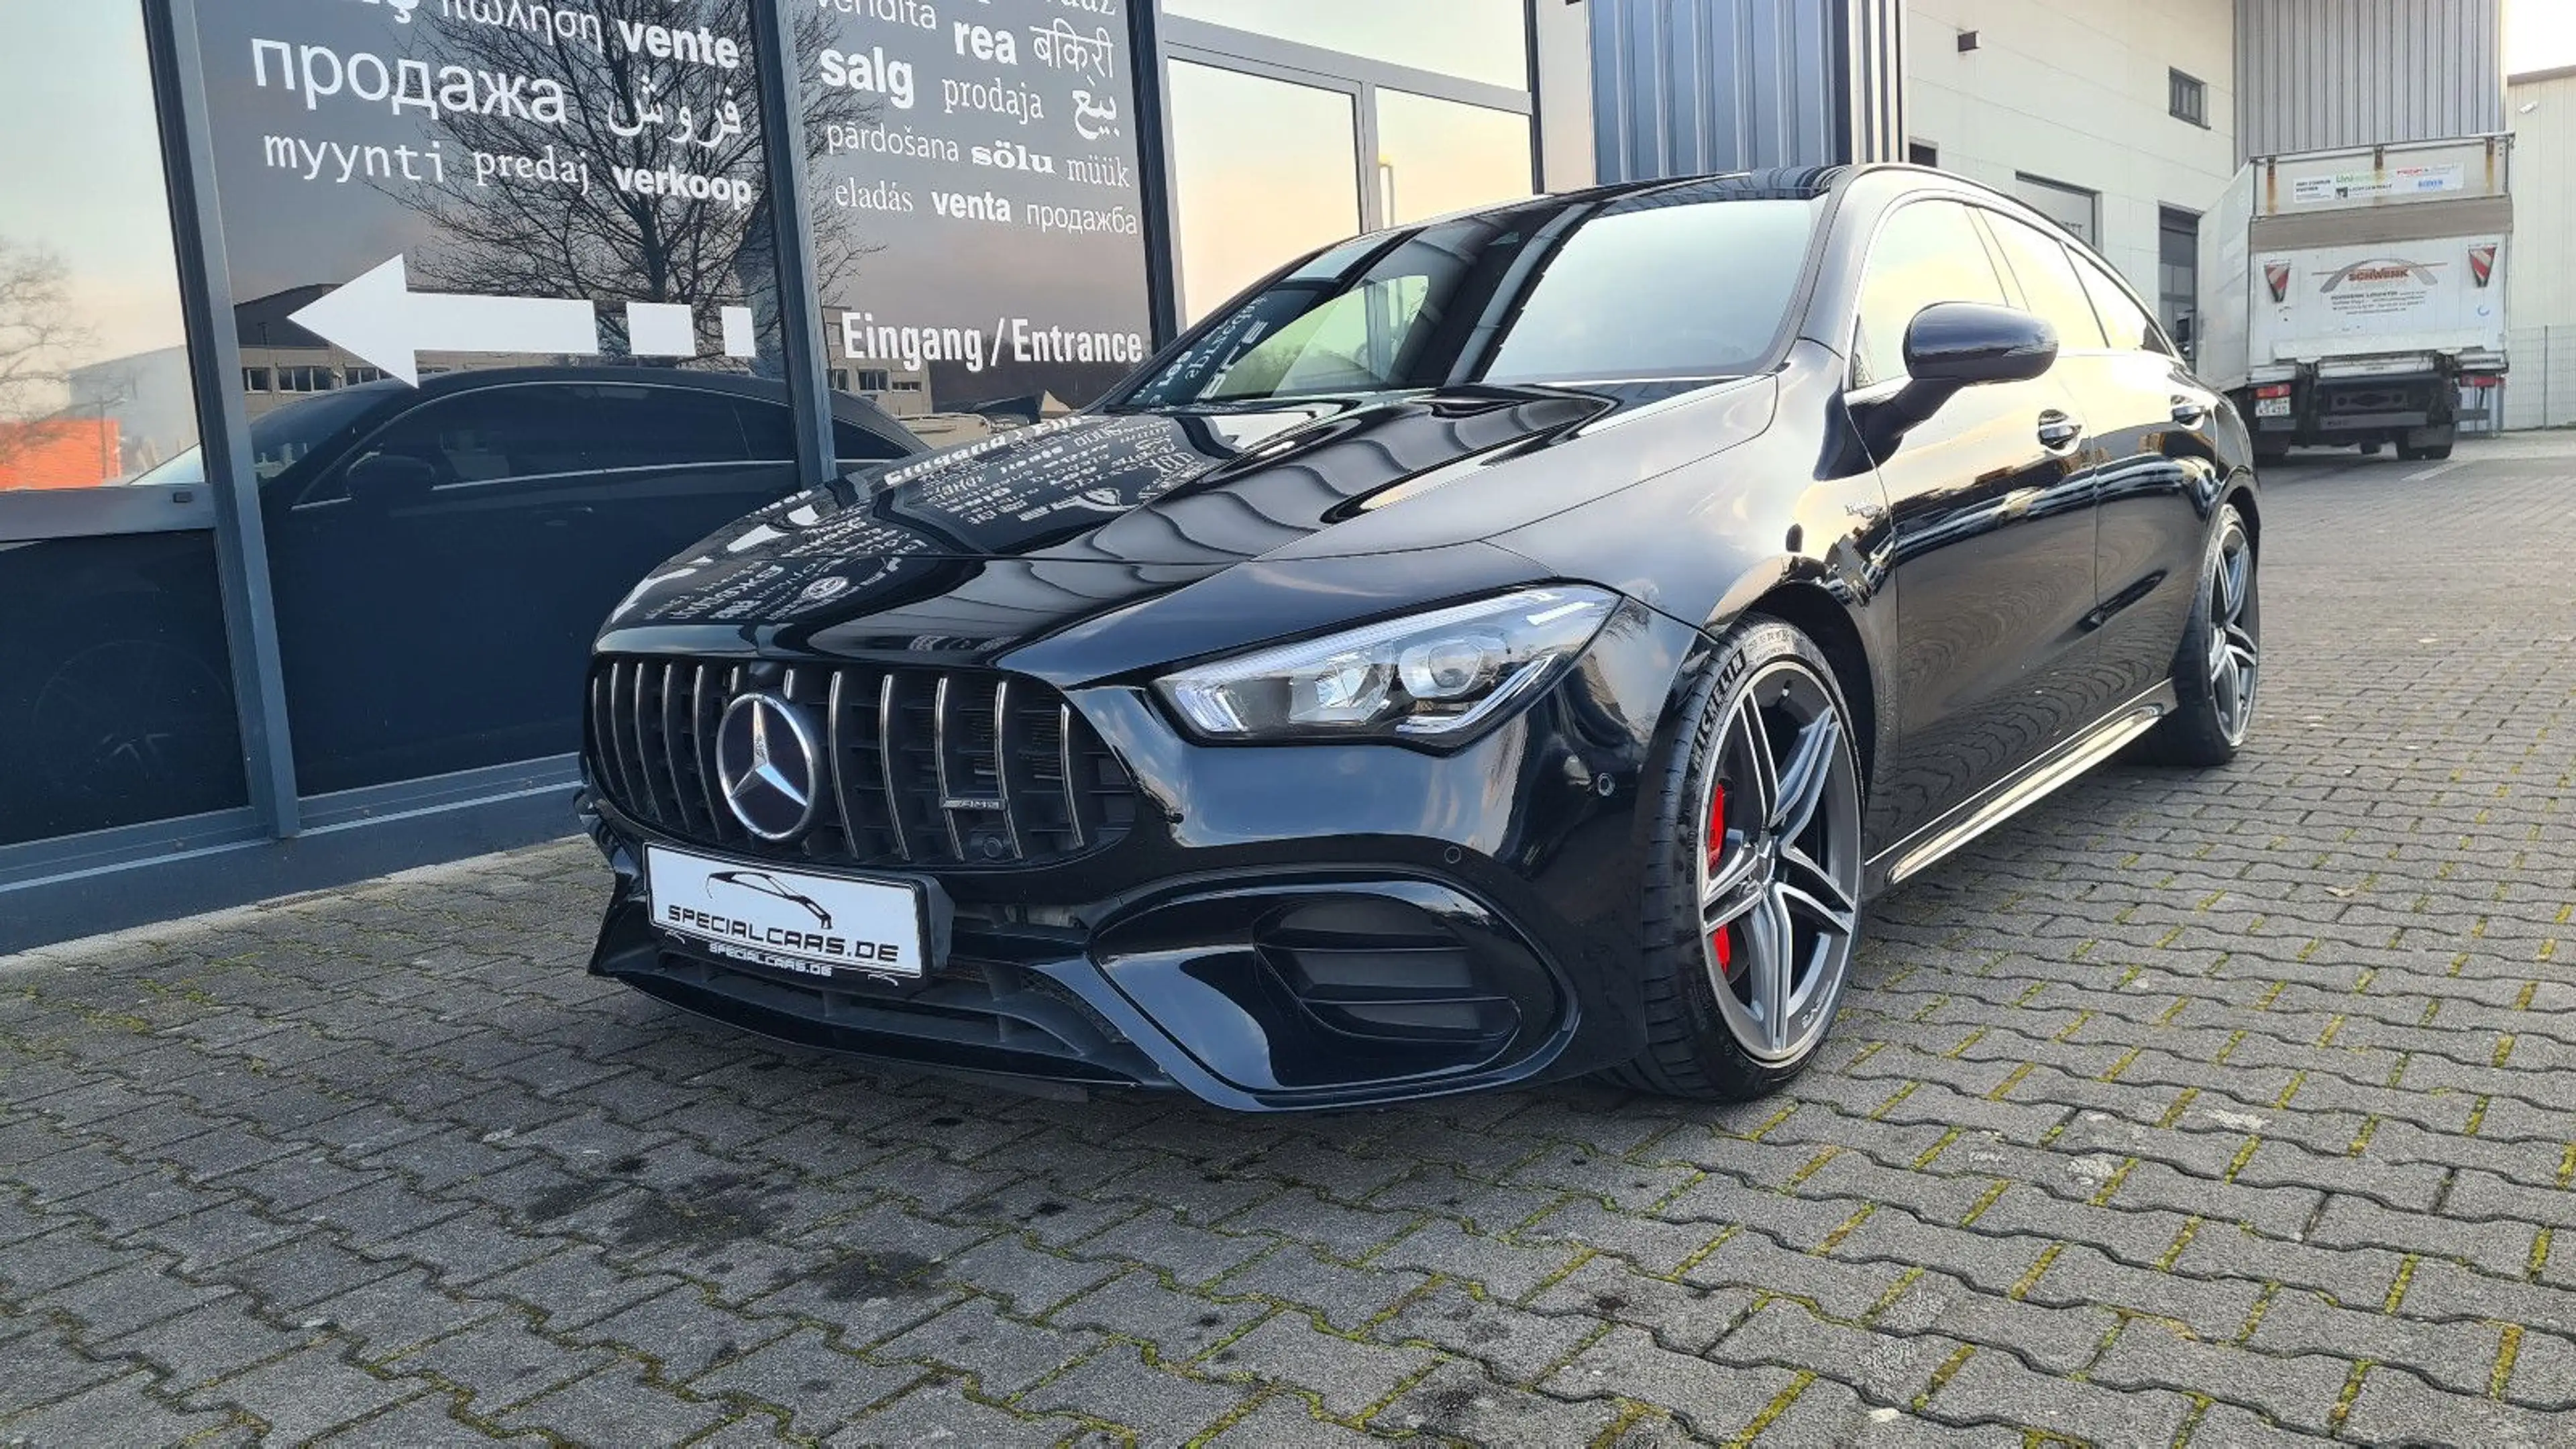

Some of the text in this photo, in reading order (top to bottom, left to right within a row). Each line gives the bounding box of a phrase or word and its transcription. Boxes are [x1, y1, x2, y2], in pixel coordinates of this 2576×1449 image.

[617, 19, 741, 70] vente
[953, 21, 1018, 66] rea
[251, 38, 568, 125] продажа
[820, 47, 914, 109] salg
[941, 76, 1044, 125] prodaja
[1072, 89, 1120, 140] بيع
[264, 136, 444, 183] myynti
[826, 121, 959, 162] pārdošana
[970, 140, 1055, 176] sölu
[474, 146, 589, 195] predaj
[612, 164, 751, 209] verkoop
[1067, 156, 1130, 189] müük
[835, 177, 913, 213] eladás
[931, 191, 1011, 223] venta
[1026, 202, 1138, 235] продажба
[842, 312, 983, 373] Eingang
[990, 317, 1006, 367] /
[1012, 319, 1142, 363] Entrance
[667, 904, 900, 962] SPECIALCARS.DE
